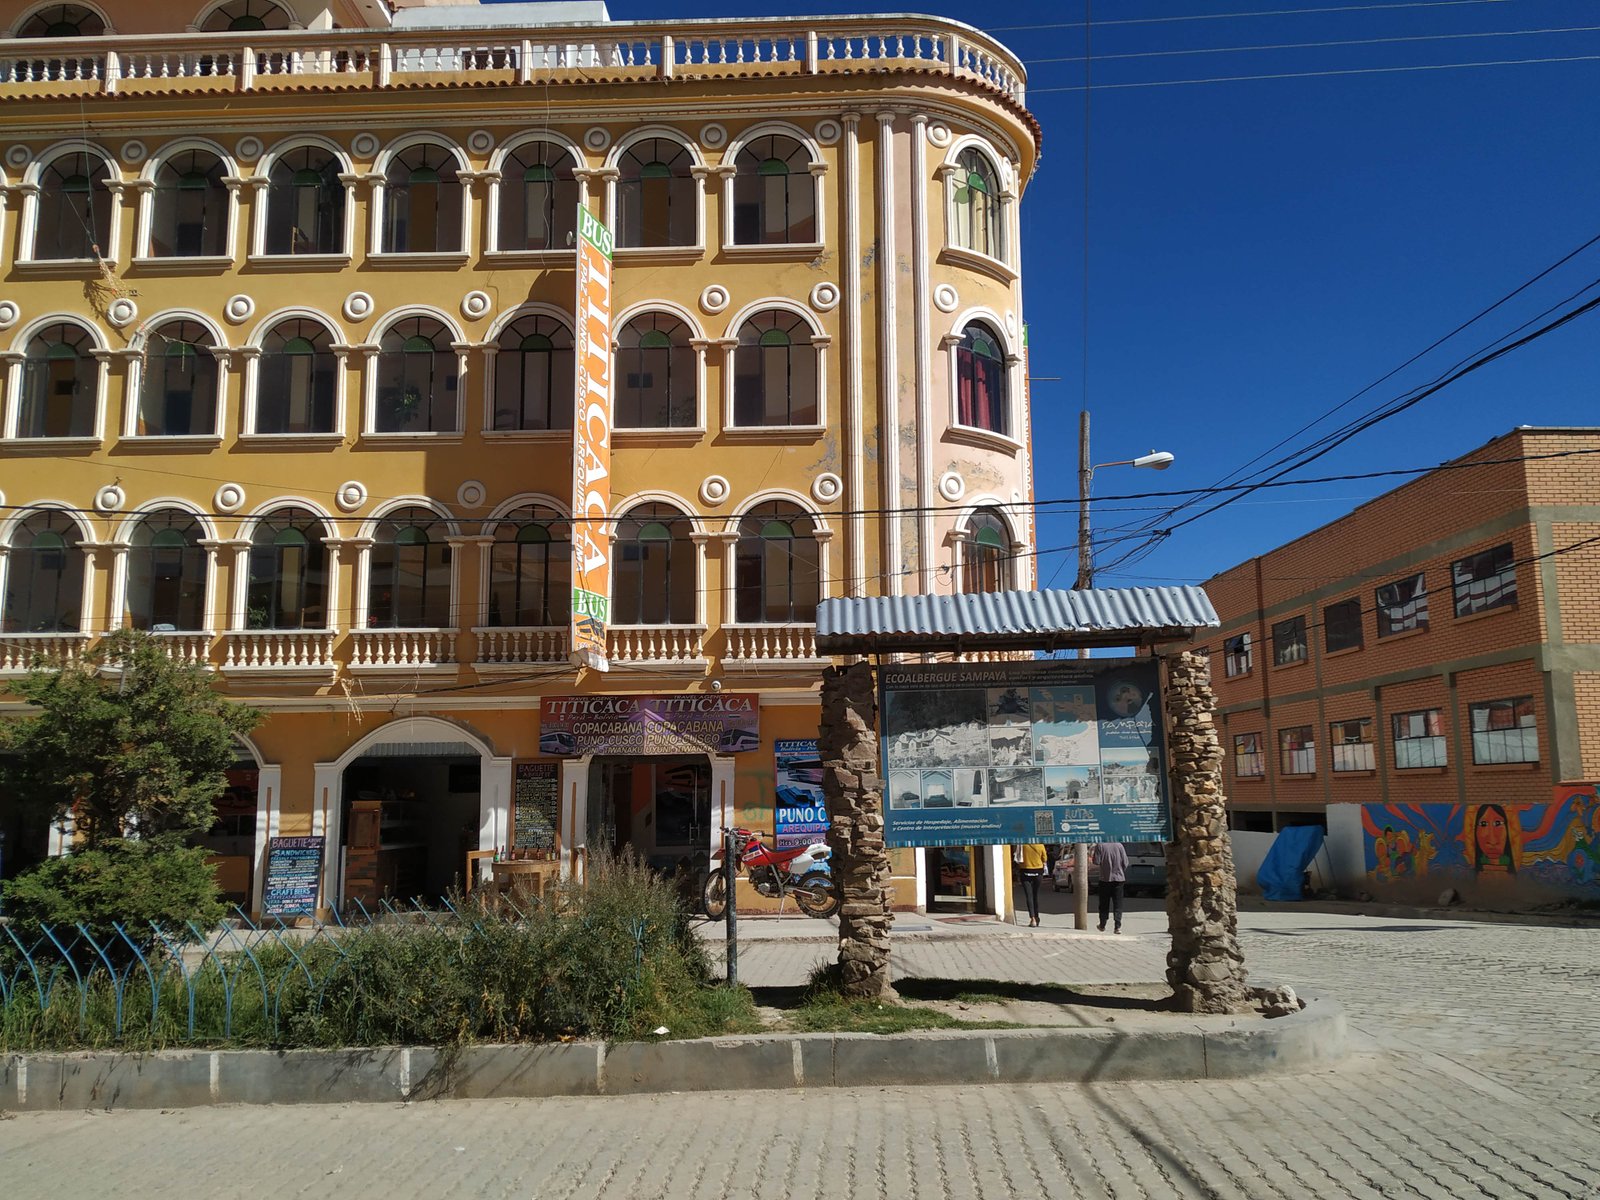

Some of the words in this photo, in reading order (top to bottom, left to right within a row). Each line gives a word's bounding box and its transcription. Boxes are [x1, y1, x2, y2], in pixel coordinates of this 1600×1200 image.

[582, 210, 612, 256] BUS
[580, 238, 588, 261] LA
[580, 262, 588, 297] PAZ
[579, 365, 587, 422] CUSCO
[585, 257, 610, 577] TITICACA
[577, 433, 586, 514] AREQUIPA
[575, 533, 584, 572] LIMA
[577, 591, 606, 620] BUS
[885, 672, 958, 683] ECOALBERGUE
[960, 670, 1007, 682] SAMPAYA
[547, 699, 640, 714] TITICACA
[650, 698, 753, 712] TITICACA
[572, 721, 643, 735] COPACABANA
[646, 720, 724, 733] COPACABANA
[576, 746, 598, 754] UYUNI
[603, 746, 643, 754] TIWANAKU
[645, 745, 671, 753] UYUNI
[677, 744, 720, 752] TIWANAKU
[518, 764, 556, 772] BAGUETTE
[1065, 808, 1094, 820] RUTAS
[782, 824, 827, 833] AREQUIPA
[272, 838, 307, 848] BAGUETTE
[274, 849, 318, 857] SANDWICHES
[271, 888, 294, 896] CRAFT
[294, 887, 311, 895] BEERS
